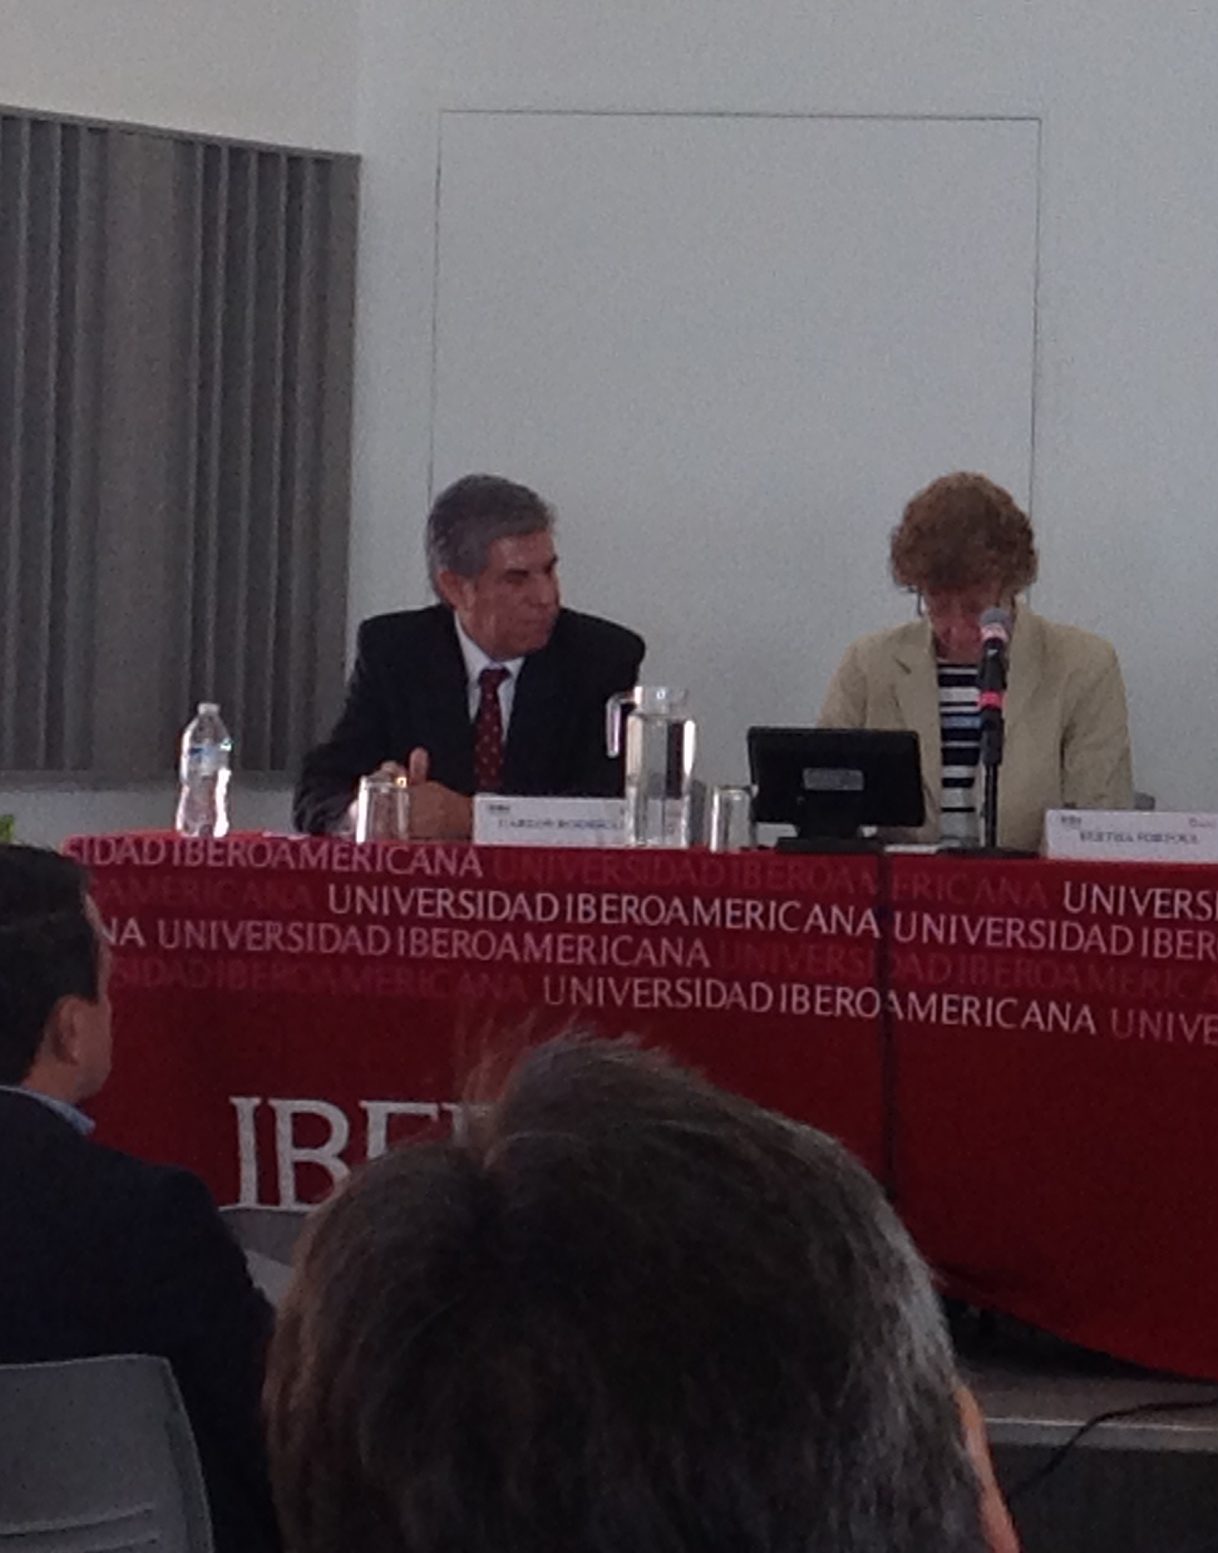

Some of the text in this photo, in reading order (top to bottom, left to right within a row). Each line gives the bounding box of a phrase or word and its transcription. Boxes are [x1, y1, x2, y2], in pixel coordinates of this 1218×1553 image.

[172, 838, 484, 878] IBEROAMERICANA
[156, 919, 392, 957] UNIVERSIDAD
[398, 925, 712, 969] IBEROAMERICANA
[328, 883, 560, 923] UNIVERSIDAD
[564, 892, 883, 939] IBEROAMERICANA
[892, 910, 1135, 957] UNIVERSIDAD
[543, 975, 774, 1012] UNIVERSIDAD
[780, 984, 1097, 1036] IBEROAMERICANA
